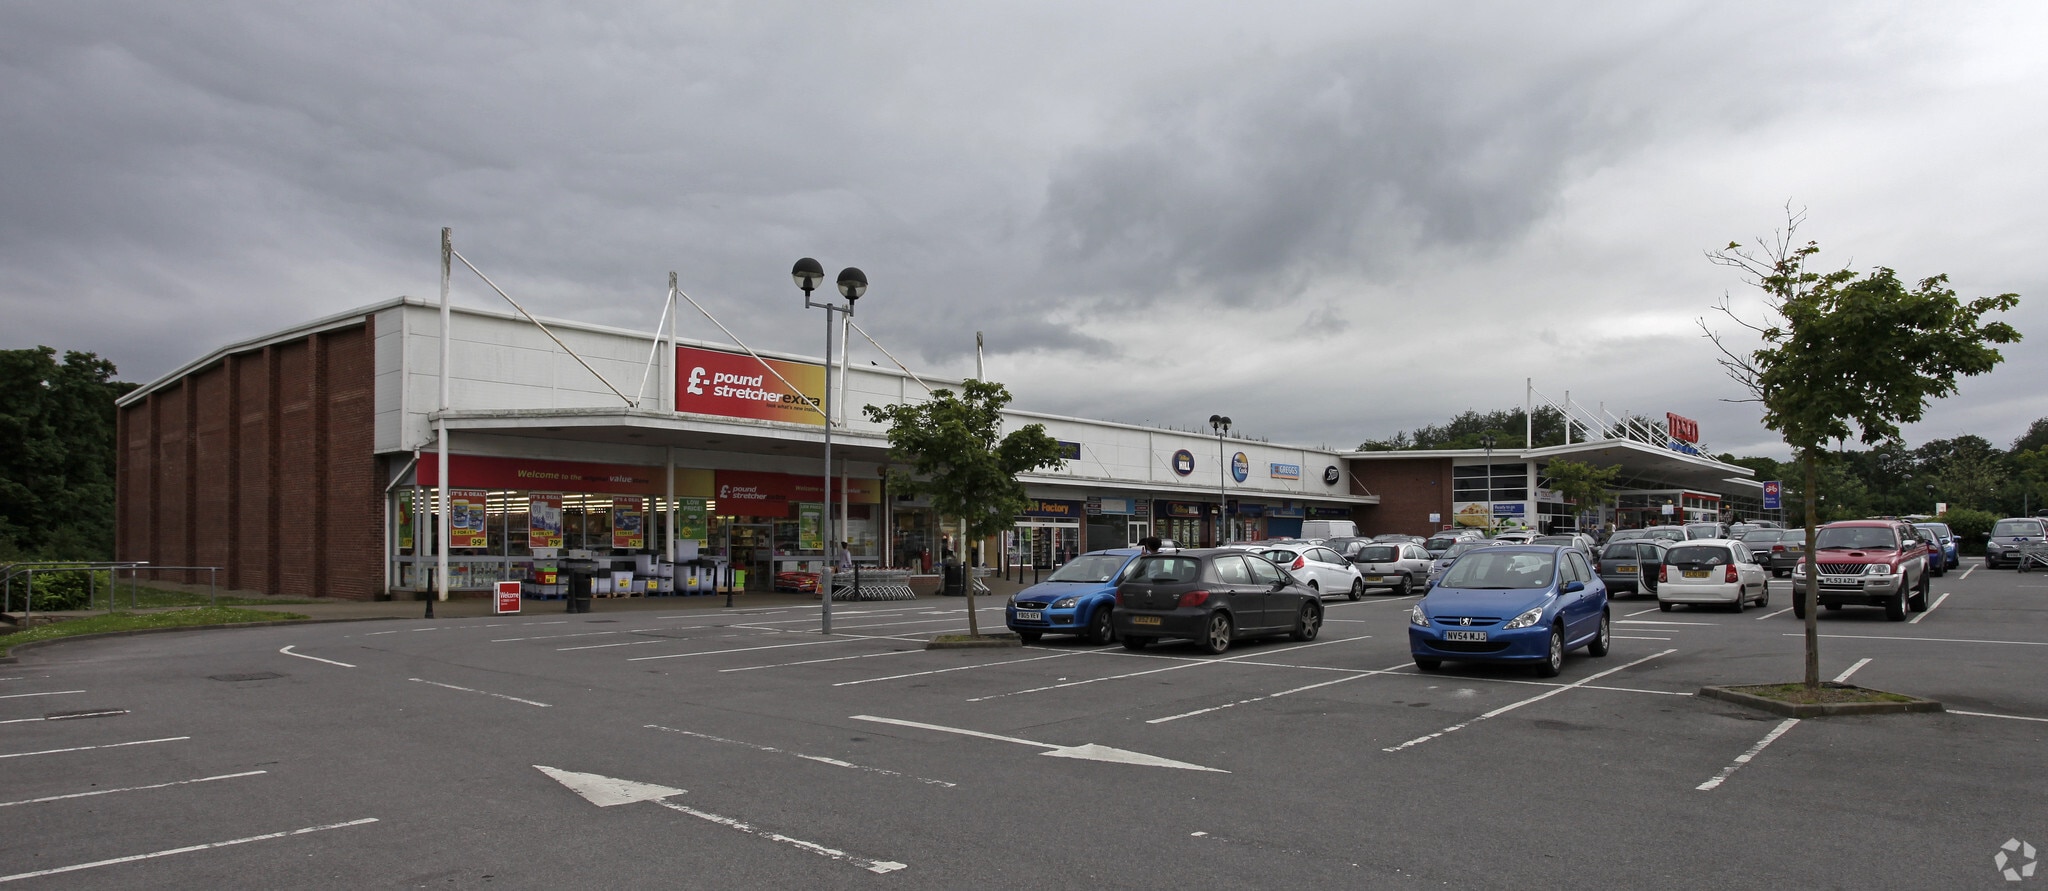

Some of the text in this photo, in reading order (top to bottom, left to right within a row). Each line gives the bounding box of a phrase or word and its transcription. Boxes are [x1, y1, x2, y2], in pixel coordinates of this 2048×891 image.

[713, 372, 763, 388] pound
[1666, 412, 1699, 444] TESCO
[1178, 461, 1191, 471] HILL
[1279, 465, 1298, 475] GREGGS
[517, 469, 560, 480] Welcome
[609, 475, 632, 483] value
[1042, 502, 1069, 515] Factory
[1447, 631, 1468, 640] NV54
